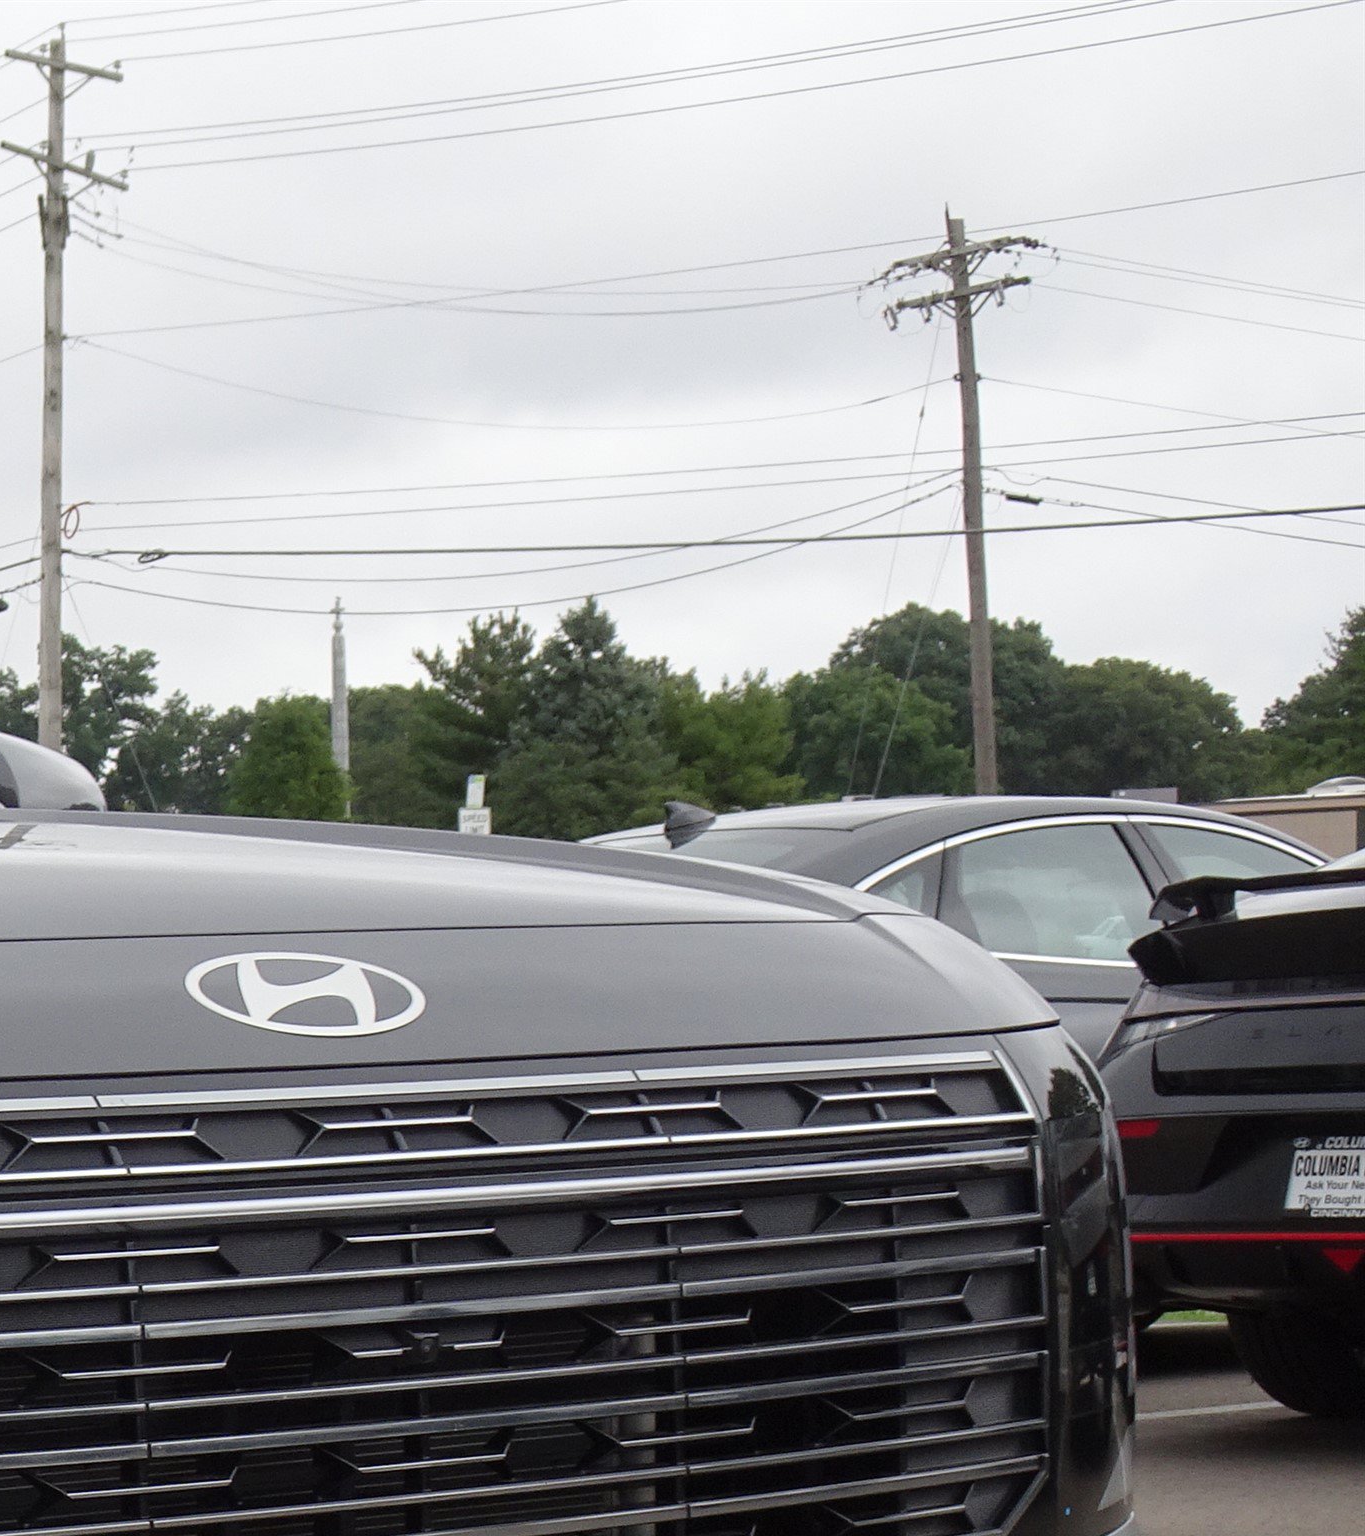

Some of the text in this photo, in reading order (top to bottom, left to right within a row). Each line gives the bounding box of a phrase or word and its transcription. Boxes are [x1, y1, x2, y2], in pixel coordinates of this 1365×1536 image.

[1295, 1155, 1361, 1177] COLUMBIA
[1305, 1180, 1324, 1190] Ask
[1326, 1180, 1349, 1190] Your
[1298, 1194, 1362, 1207] They Bought
